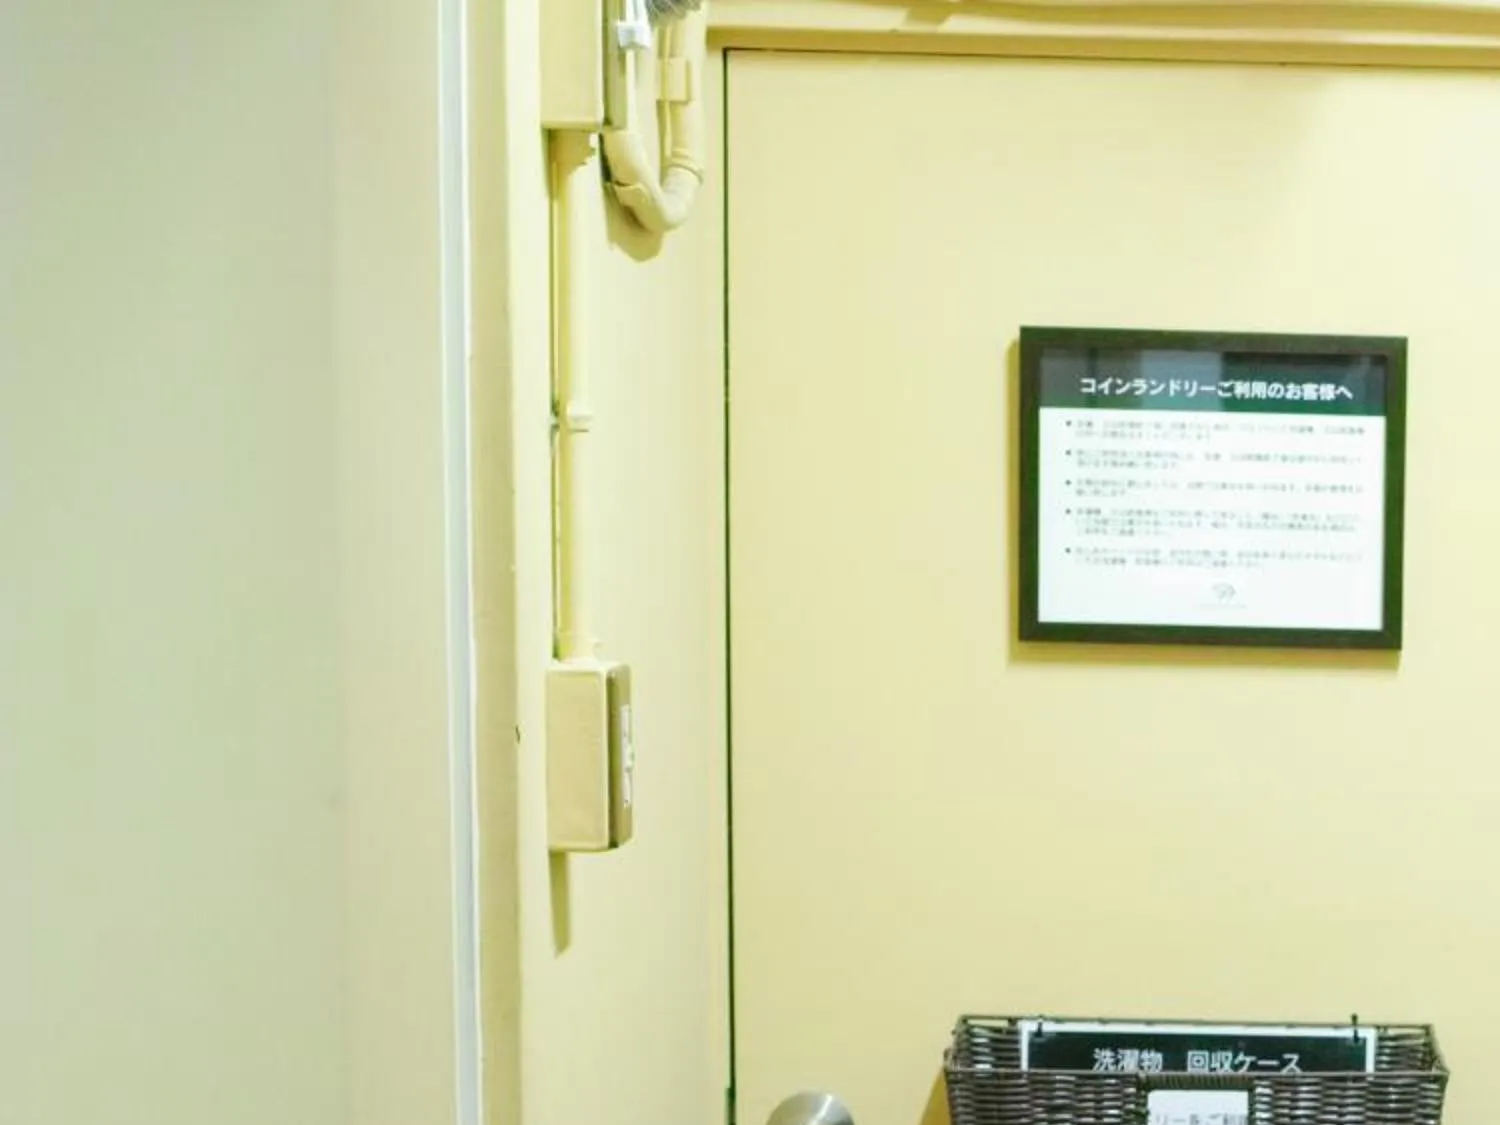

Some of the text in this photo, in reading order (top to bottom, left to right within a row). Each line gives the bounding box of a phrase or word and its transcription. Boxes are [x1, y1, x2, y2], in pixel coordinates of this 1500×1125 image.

[1080, 376, 1354, 401] コインランドリーご利用のお客様へ
[1093, 1048, 1301, 1073] 洗濯物 回収ケース
